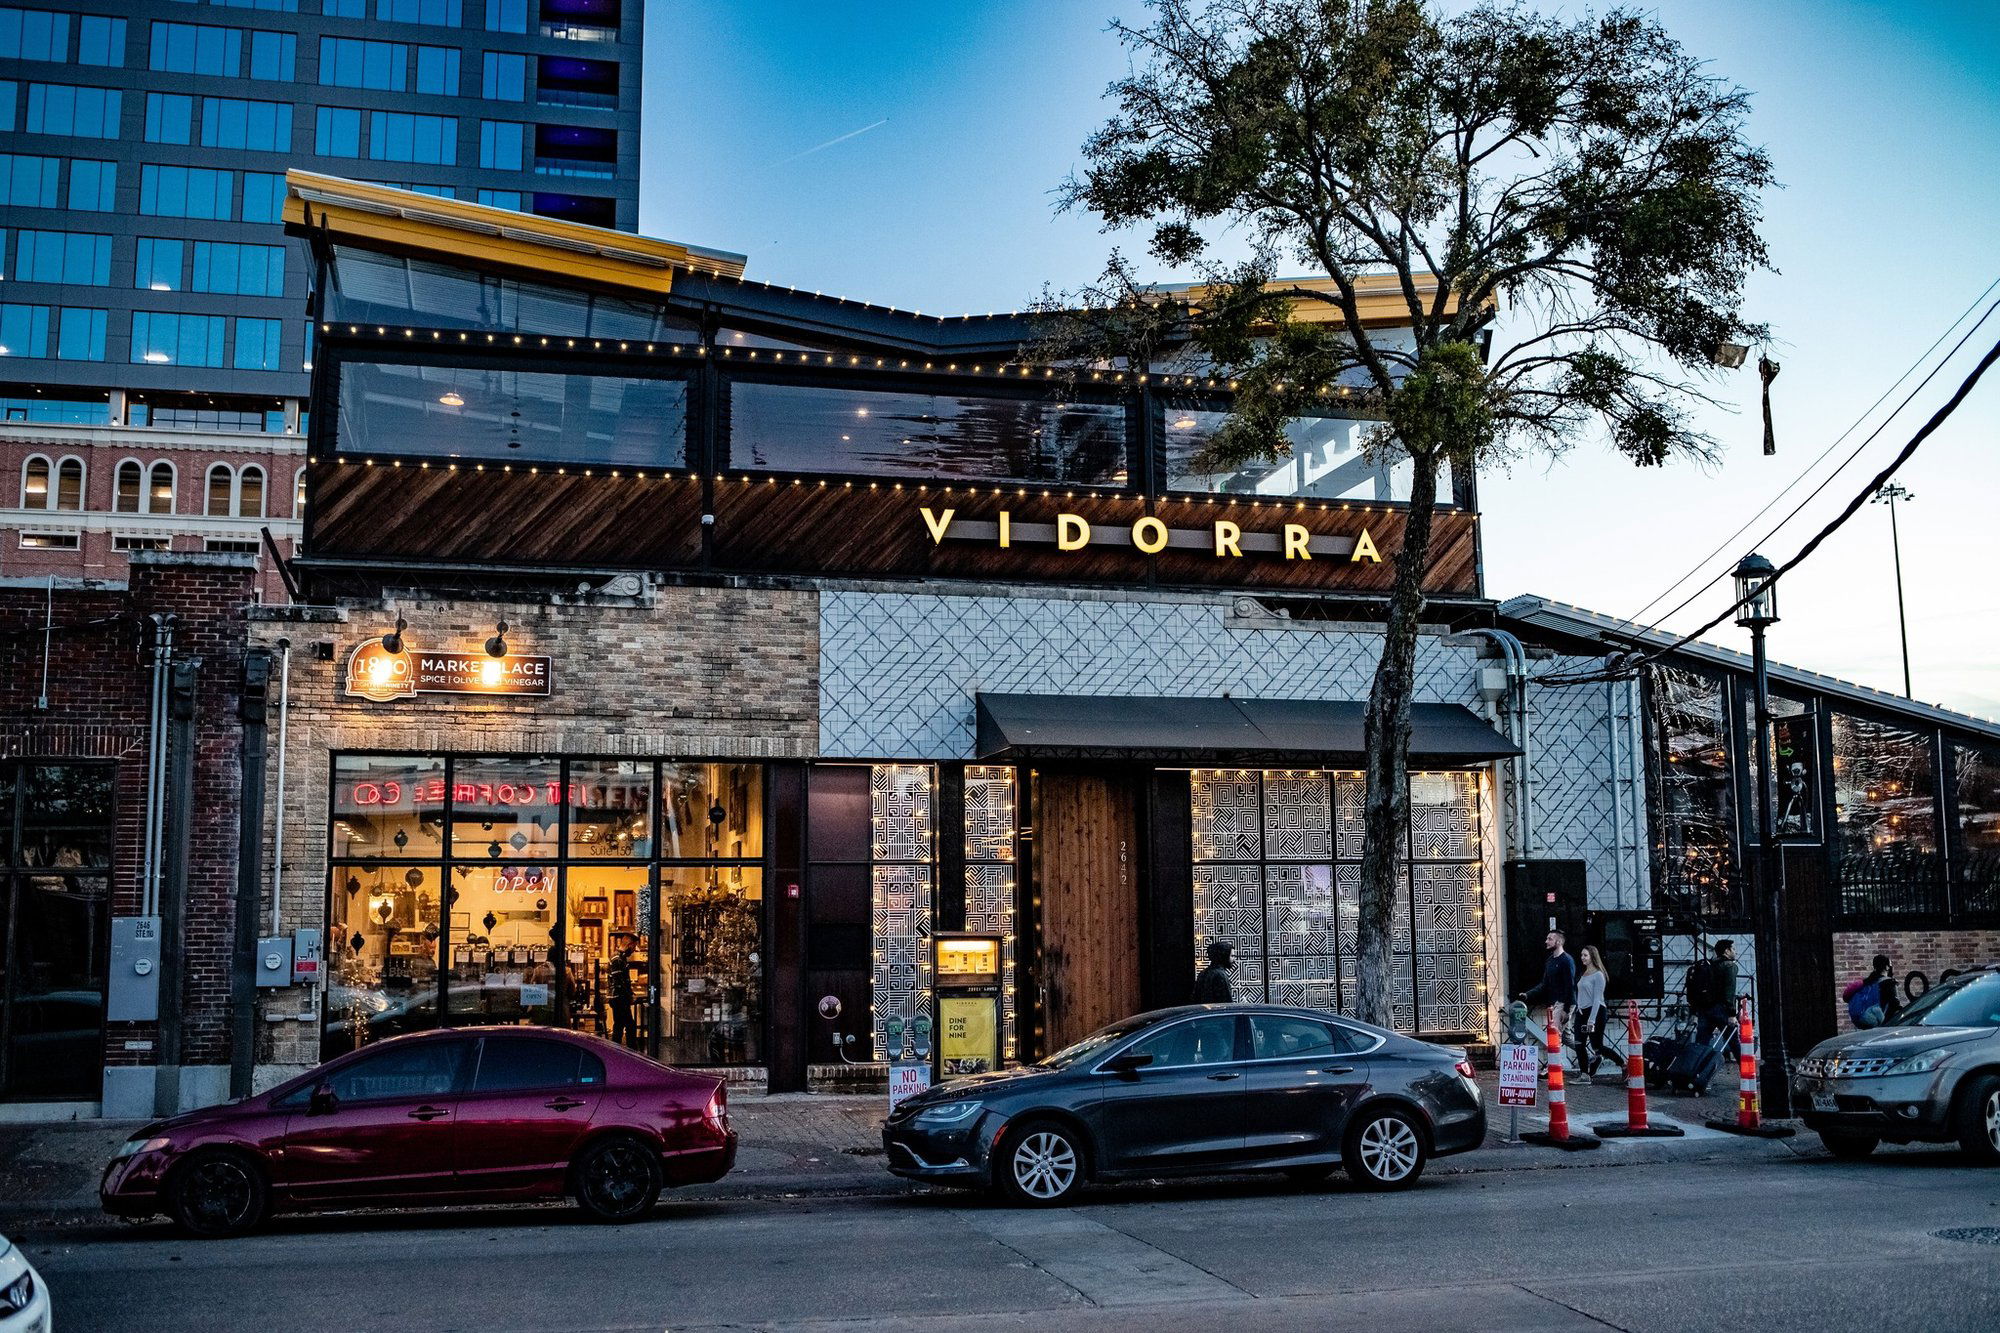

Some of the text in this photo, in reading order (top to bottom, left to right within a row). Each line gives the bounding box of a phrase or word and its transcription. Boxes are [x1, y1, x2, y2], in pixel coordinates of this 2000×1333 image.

[919, 507, 1382, 562] VIDORRA
[357, 656, 408, 675] 180
[421, 658, 544, 675] MARKELACE
[420, 674, 446, 684] SPICE
[453, 676, 480, 685] OLIVE
[504, 677, 545, 687] VINEGAR
[590, 845, 632, 856] Suite 150
[1119, 840, 1127, 885] 2642
[494, 876, 556, 895] OPEN
[136, 920, 151, 930] 2646
[948, 1024, 965, 1032] FOR
[1513, 1048, 1527, 1061] NO
[1503, 1060, 1536, 1071] PARKING
[902, 1069, 917, 1083] NO
[1502, 1073, 1535, 1083] STANDING
[892, 1083, 927, 1095] PARKING
[1501, 1088, 1535, 1099] TOW-AWAY
